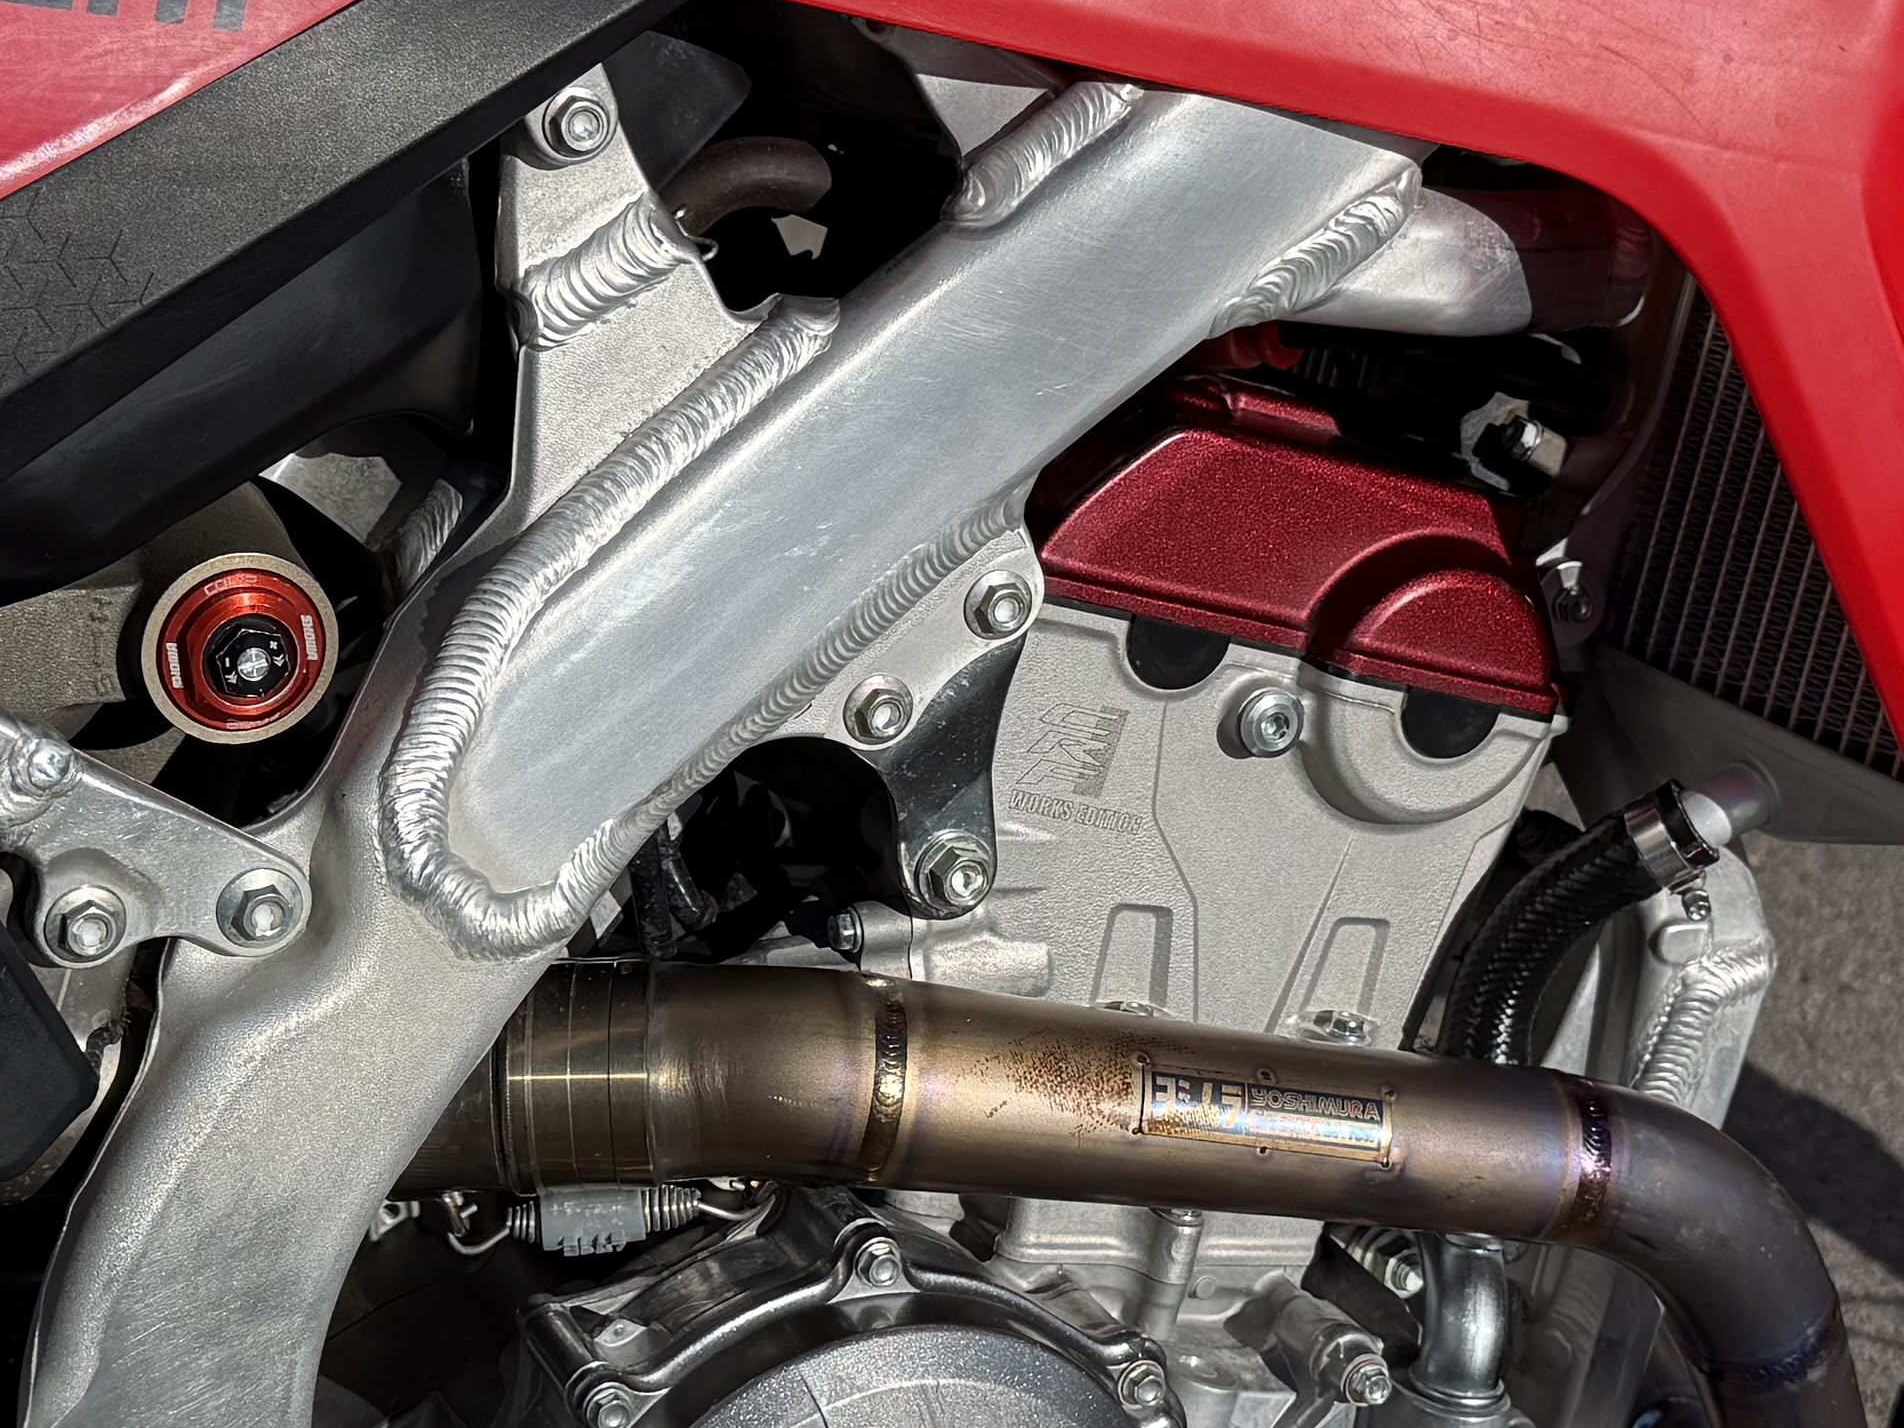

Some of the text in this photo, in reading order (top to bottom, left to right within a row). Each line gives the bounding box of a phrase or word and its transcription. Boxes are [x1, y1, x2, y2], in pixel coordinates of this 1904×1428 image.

[1008, 788, 1145, 836] WORKS EDITION
[1251, 1087, 1382, 1122] YOSHIMURA
